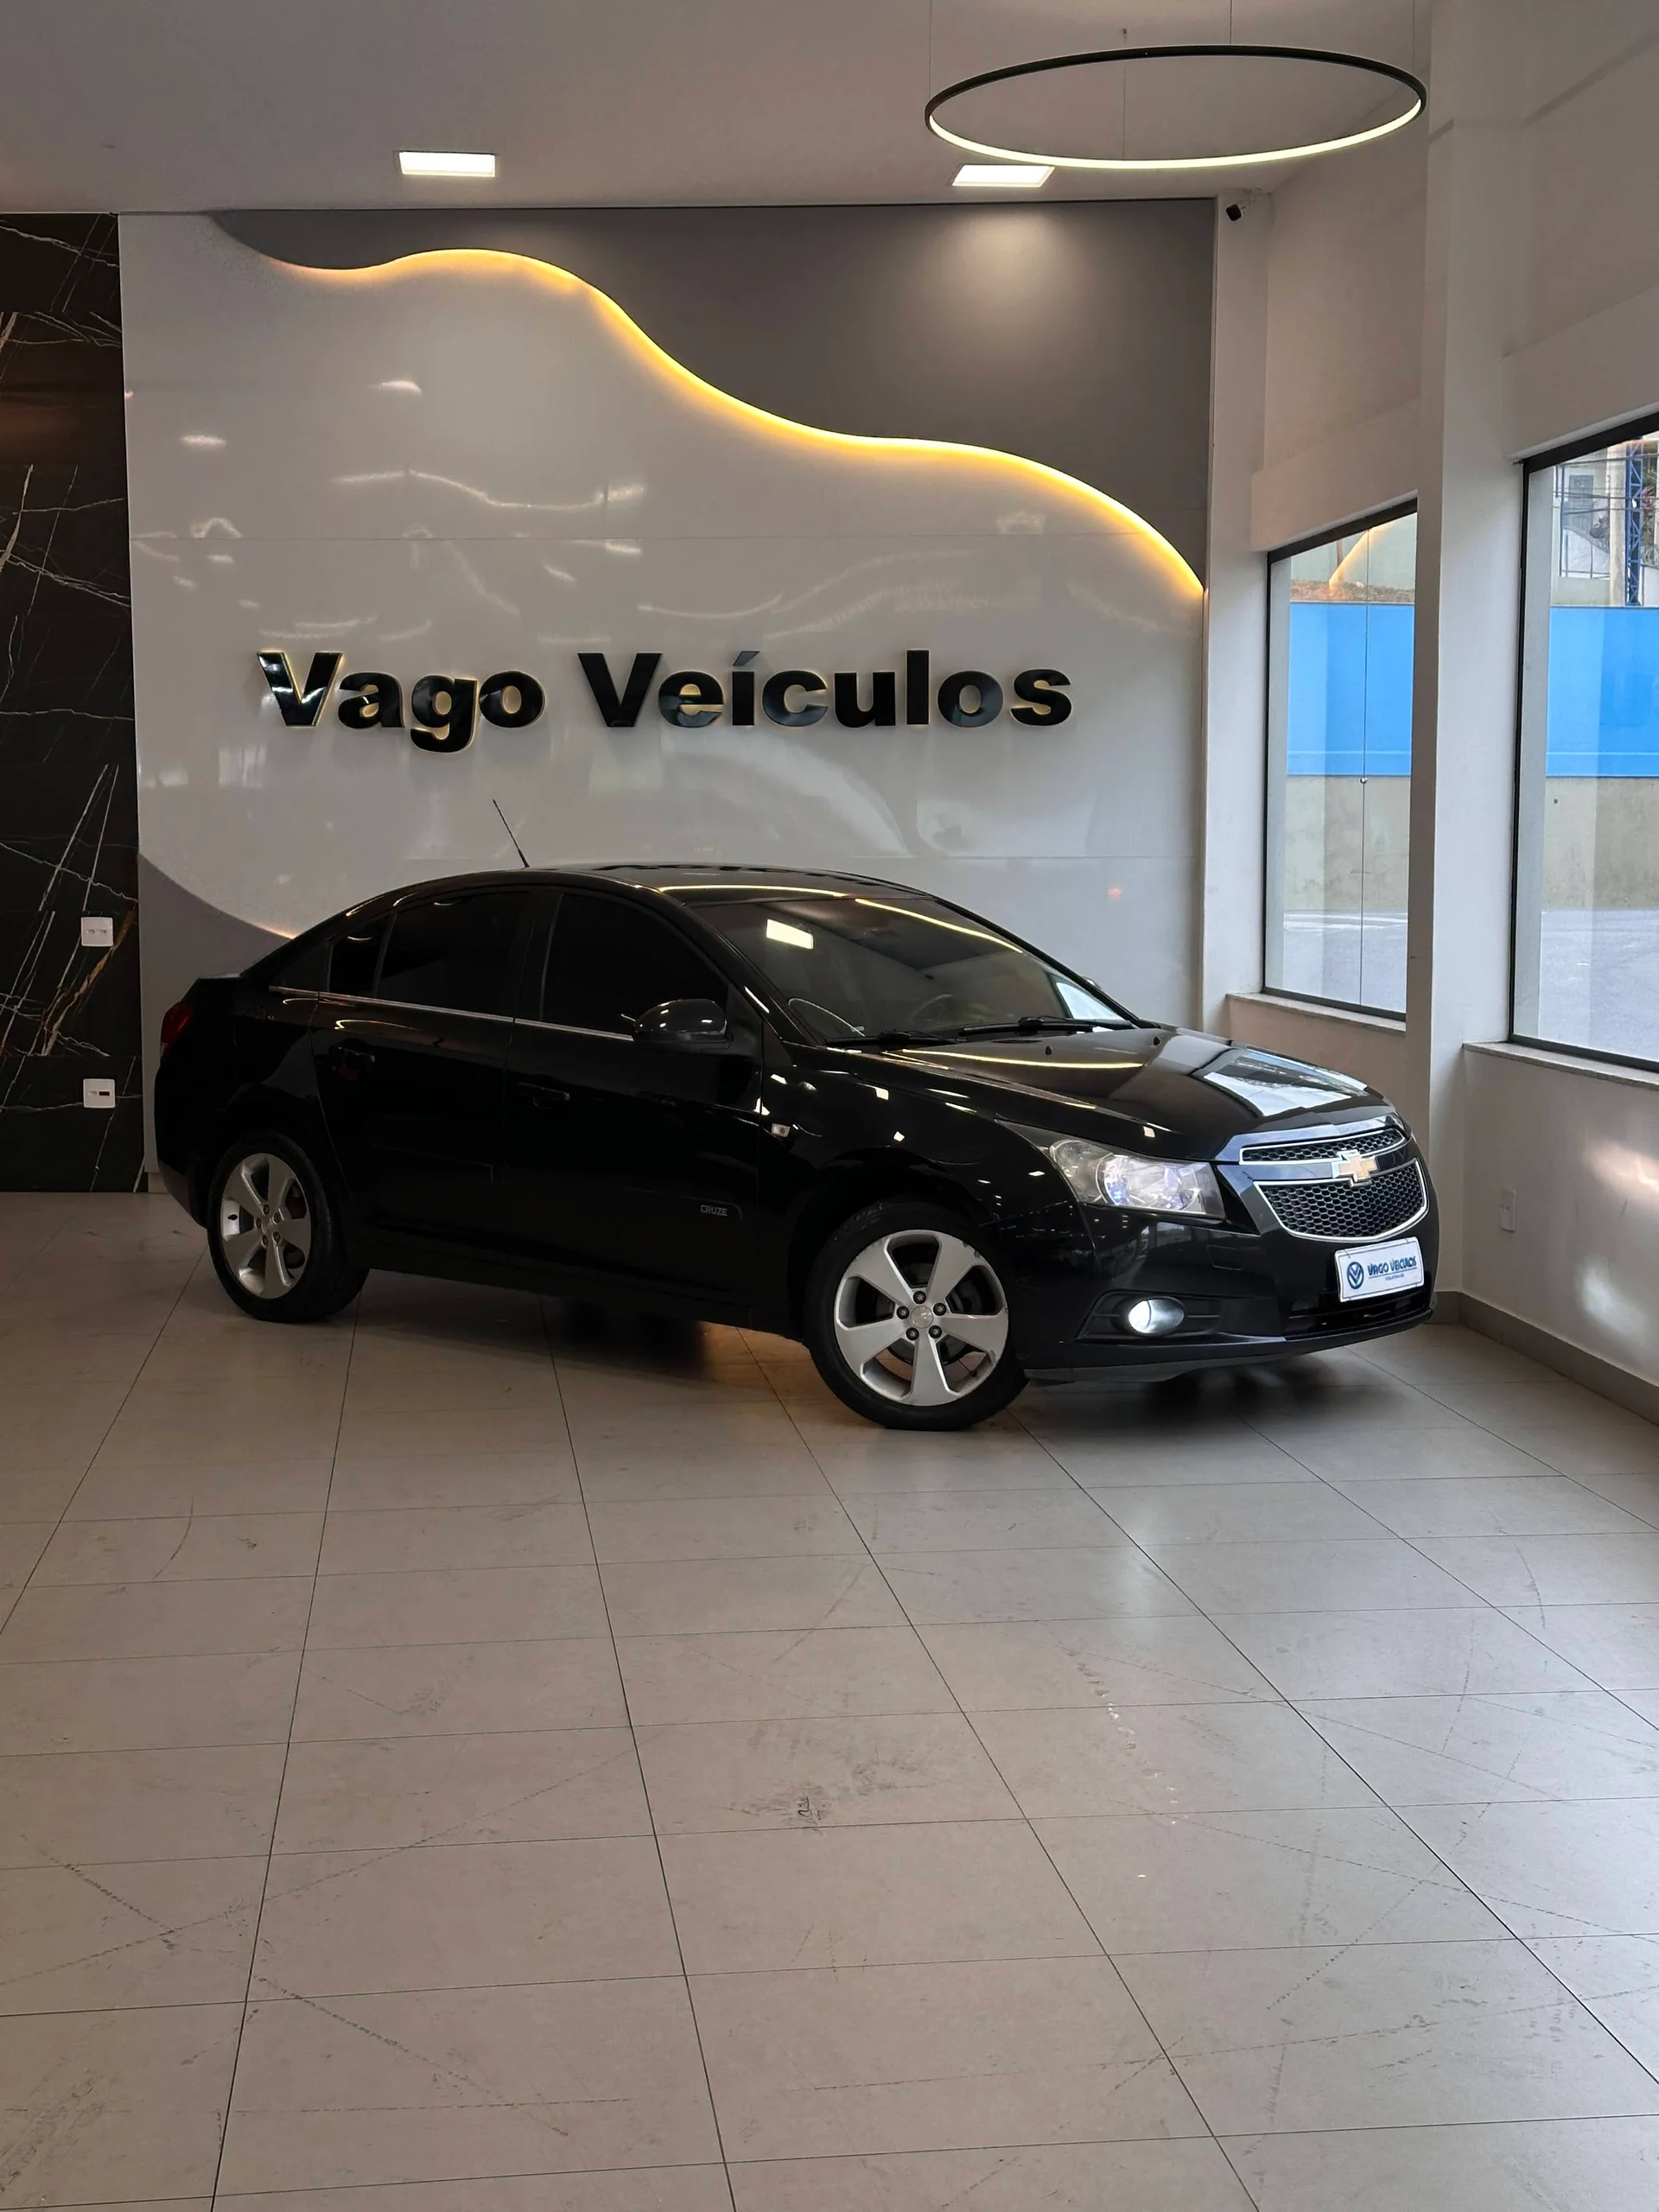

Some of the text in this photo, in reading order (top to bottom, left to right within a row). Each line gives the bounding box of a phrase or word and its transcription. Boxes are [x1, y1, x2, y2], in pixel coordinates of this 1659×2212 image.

[257, 650, 1072, 753] Vago Veículos
[701, 1205, 728, 1217] CRUZE
[1367, 1262, 1389, 1276] VAGO
